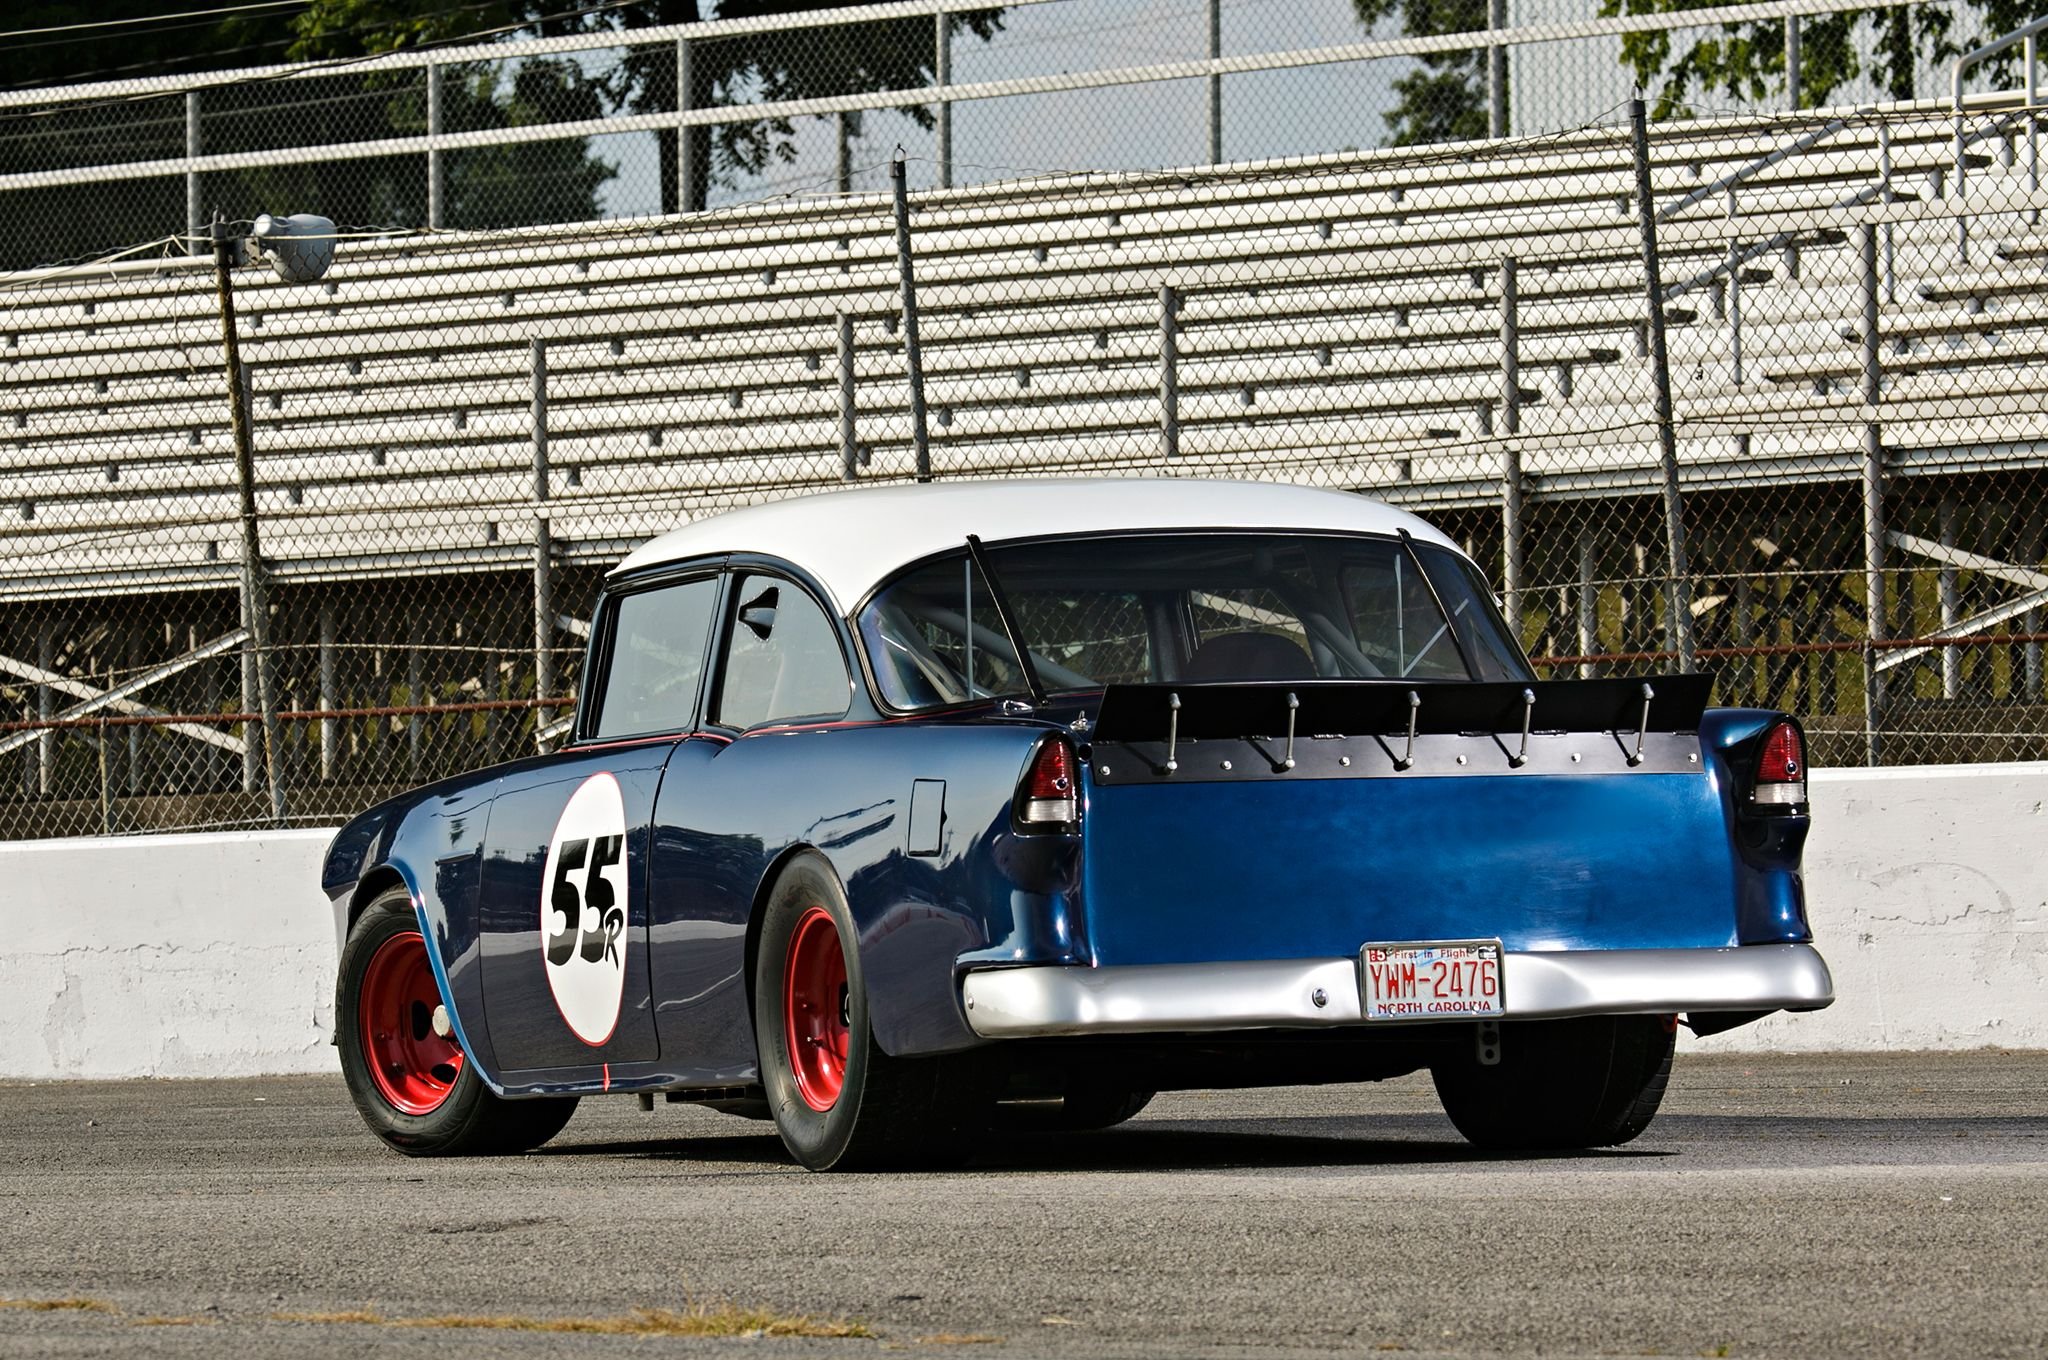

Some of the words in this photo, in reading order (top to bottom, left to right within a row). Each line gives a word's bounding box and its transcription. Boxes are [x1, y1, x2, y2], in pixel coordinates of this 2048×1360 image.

[1394, 949, 1417, 959] First
[1440, 948, 1469, 959] Flight
[1370, 961, 1496, 999] YWM-2476
[1378, 1002, 1422, 1014] NORTH
